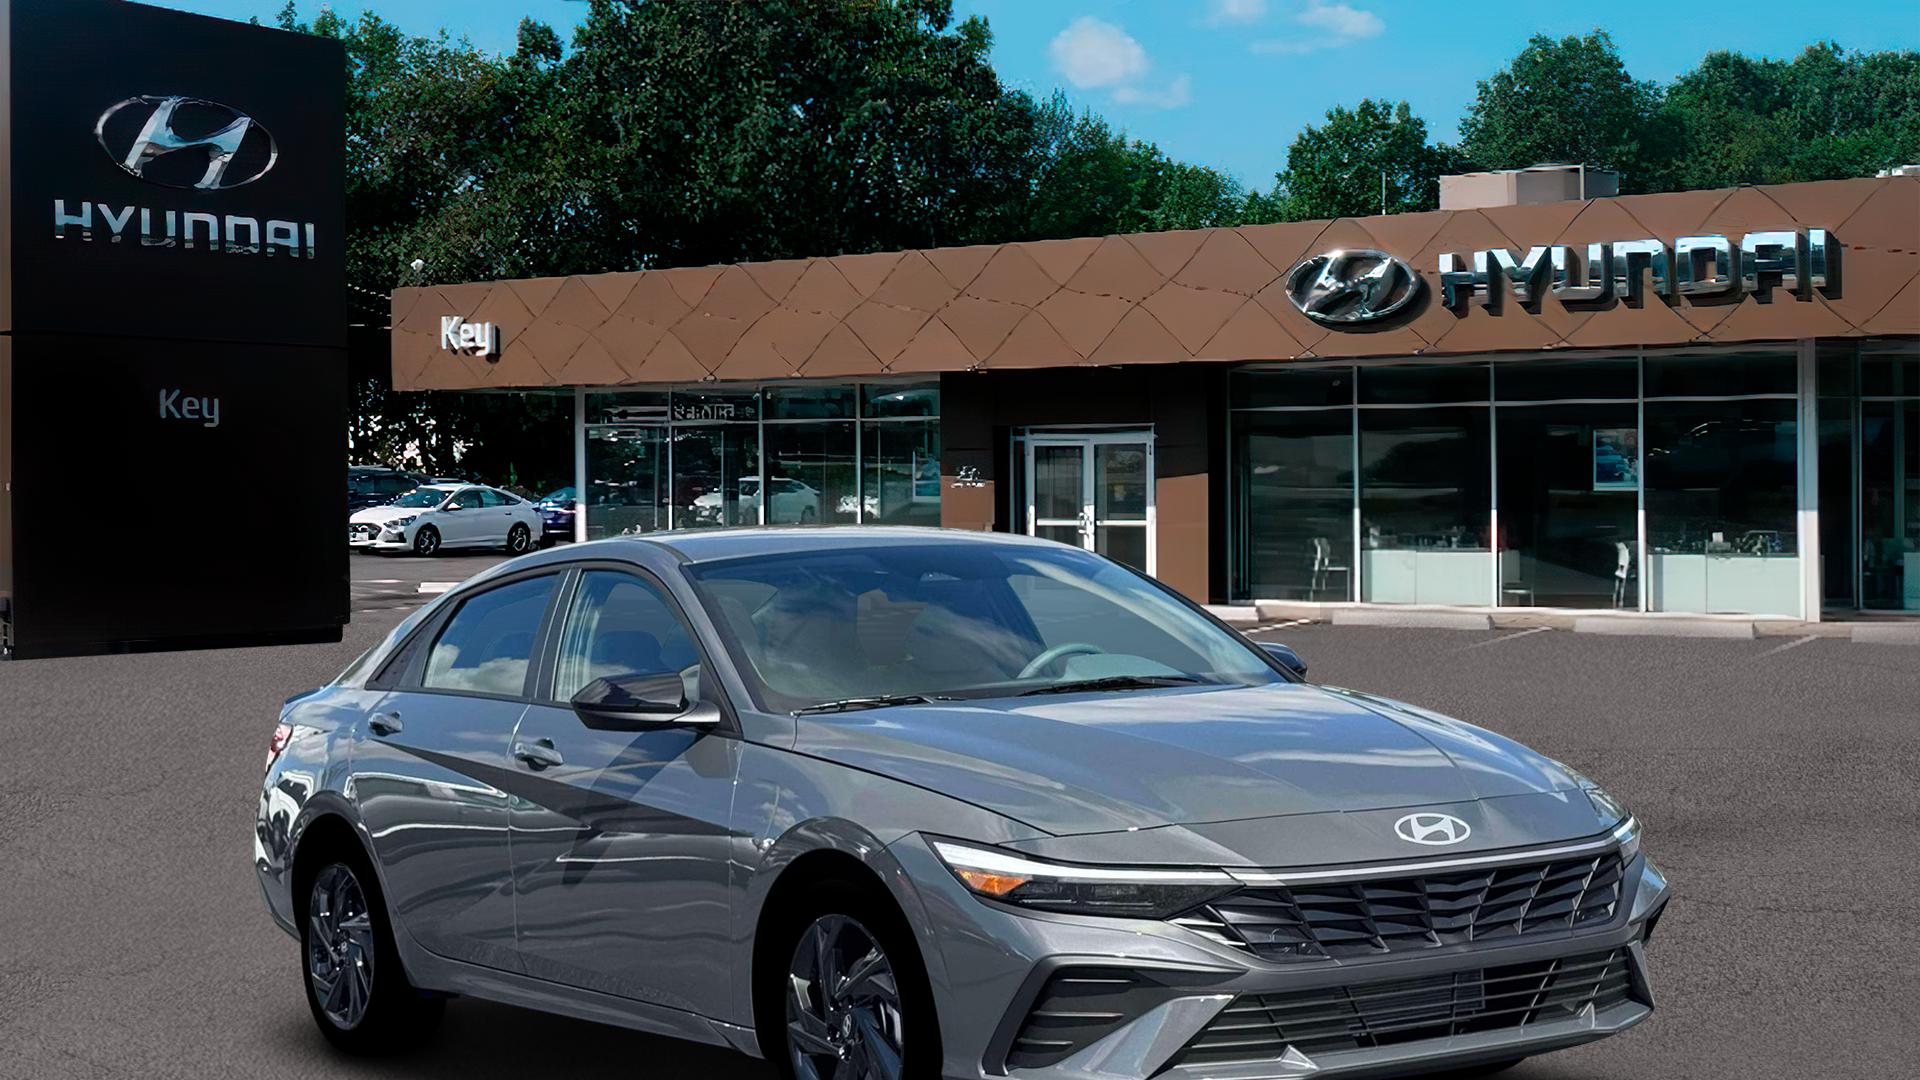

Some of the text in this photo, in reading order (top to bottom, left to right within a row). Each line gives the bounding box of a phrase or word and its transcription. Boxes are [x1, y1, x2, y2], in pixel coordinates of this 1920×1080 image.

[54, 199, 315, 259] HYUNDAI
[1438, 228, 1838, 312] HYUNDAI
[441, 315, 493, 357] Key
[159, 388, 219, 427] Key
